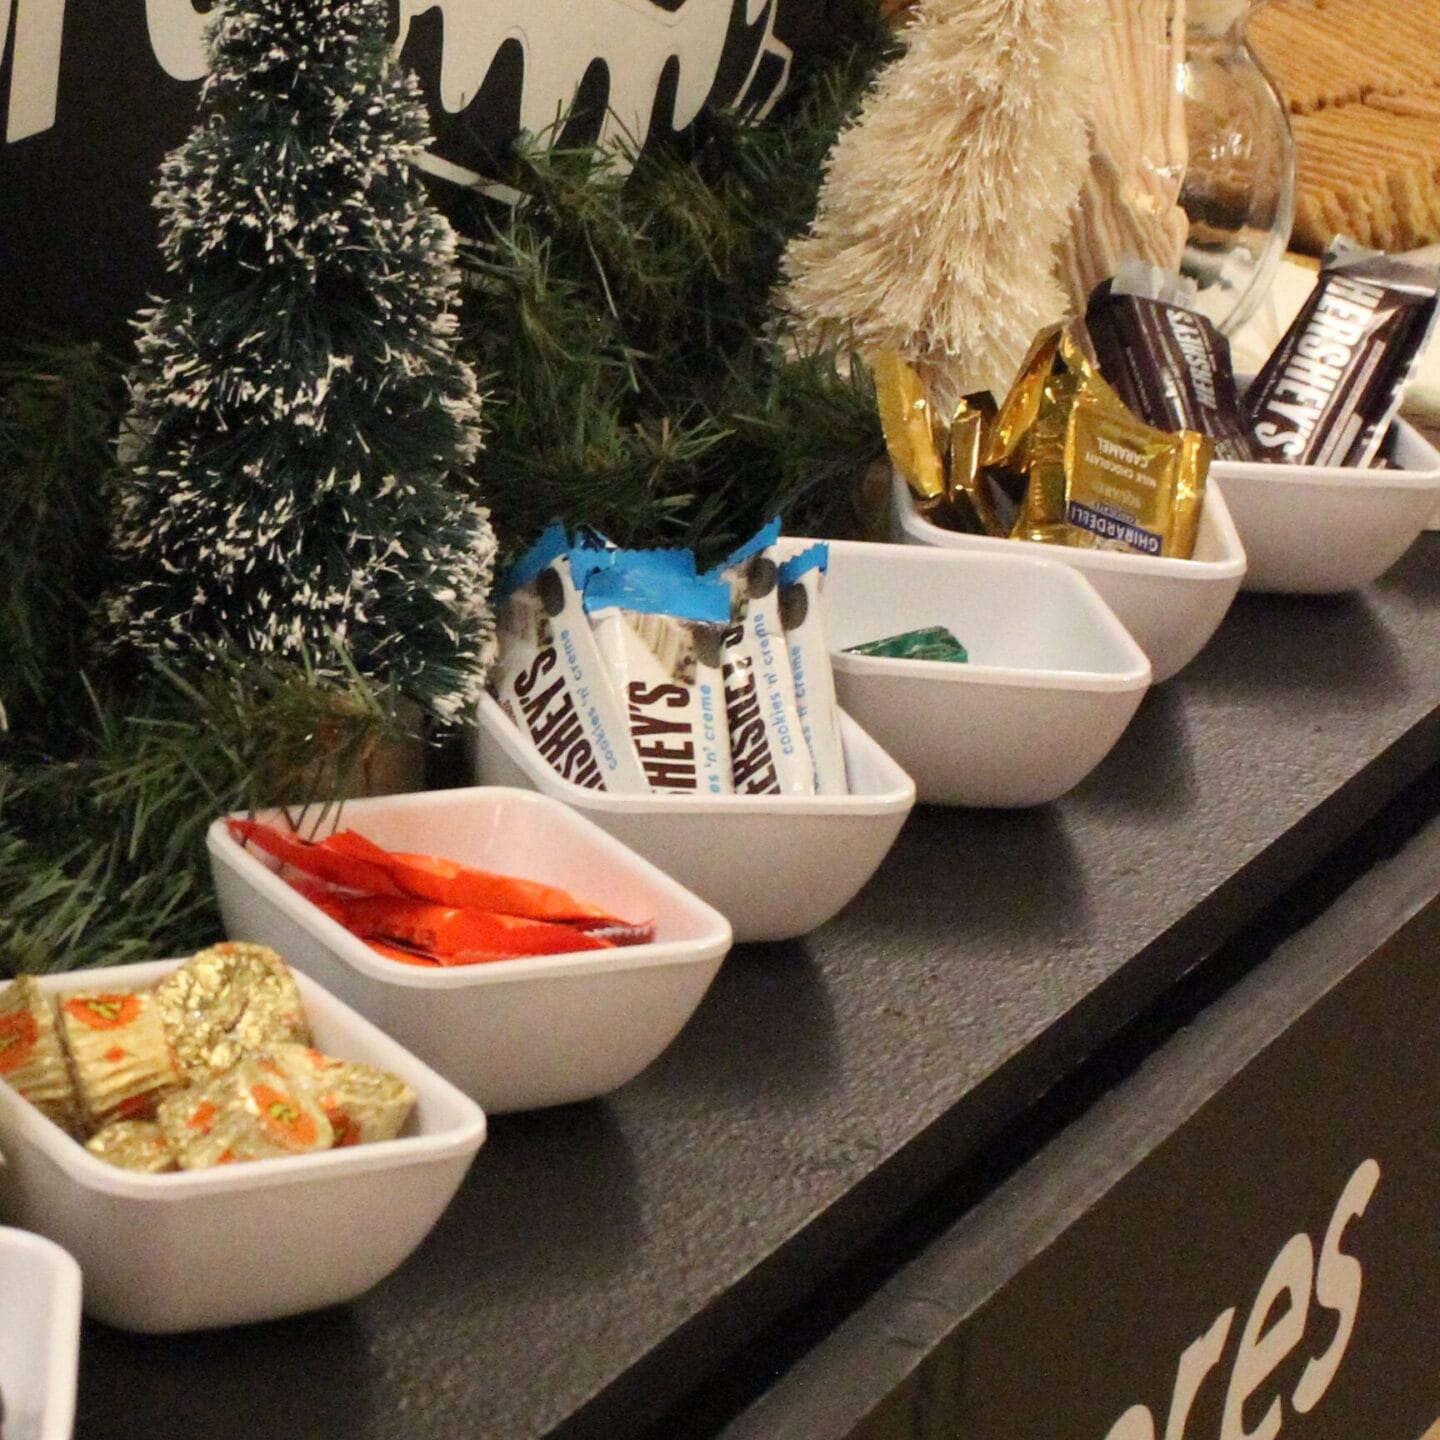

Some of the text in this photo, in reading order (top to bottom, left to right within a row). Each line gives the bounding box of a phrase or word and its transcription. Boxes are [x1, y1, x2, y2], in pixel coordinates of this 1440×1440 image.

[1166, 309, 1217, 409] HERSHEY'S
[1255, 276, 1385, 455] HERSHEY'S
[1096, 436, 1149, 468] CARAMEL
[1071, 506, 1159, 552] GHIRARDELLI
[560, 629, 583, 681] creme
[754, 613, 774, 665] creme
[791, 644, 807, 699] creme
[588, 706, 618, 771] cookies
[700, 684, 715, 741] creme
[770, 692, 794, 755] cookies
